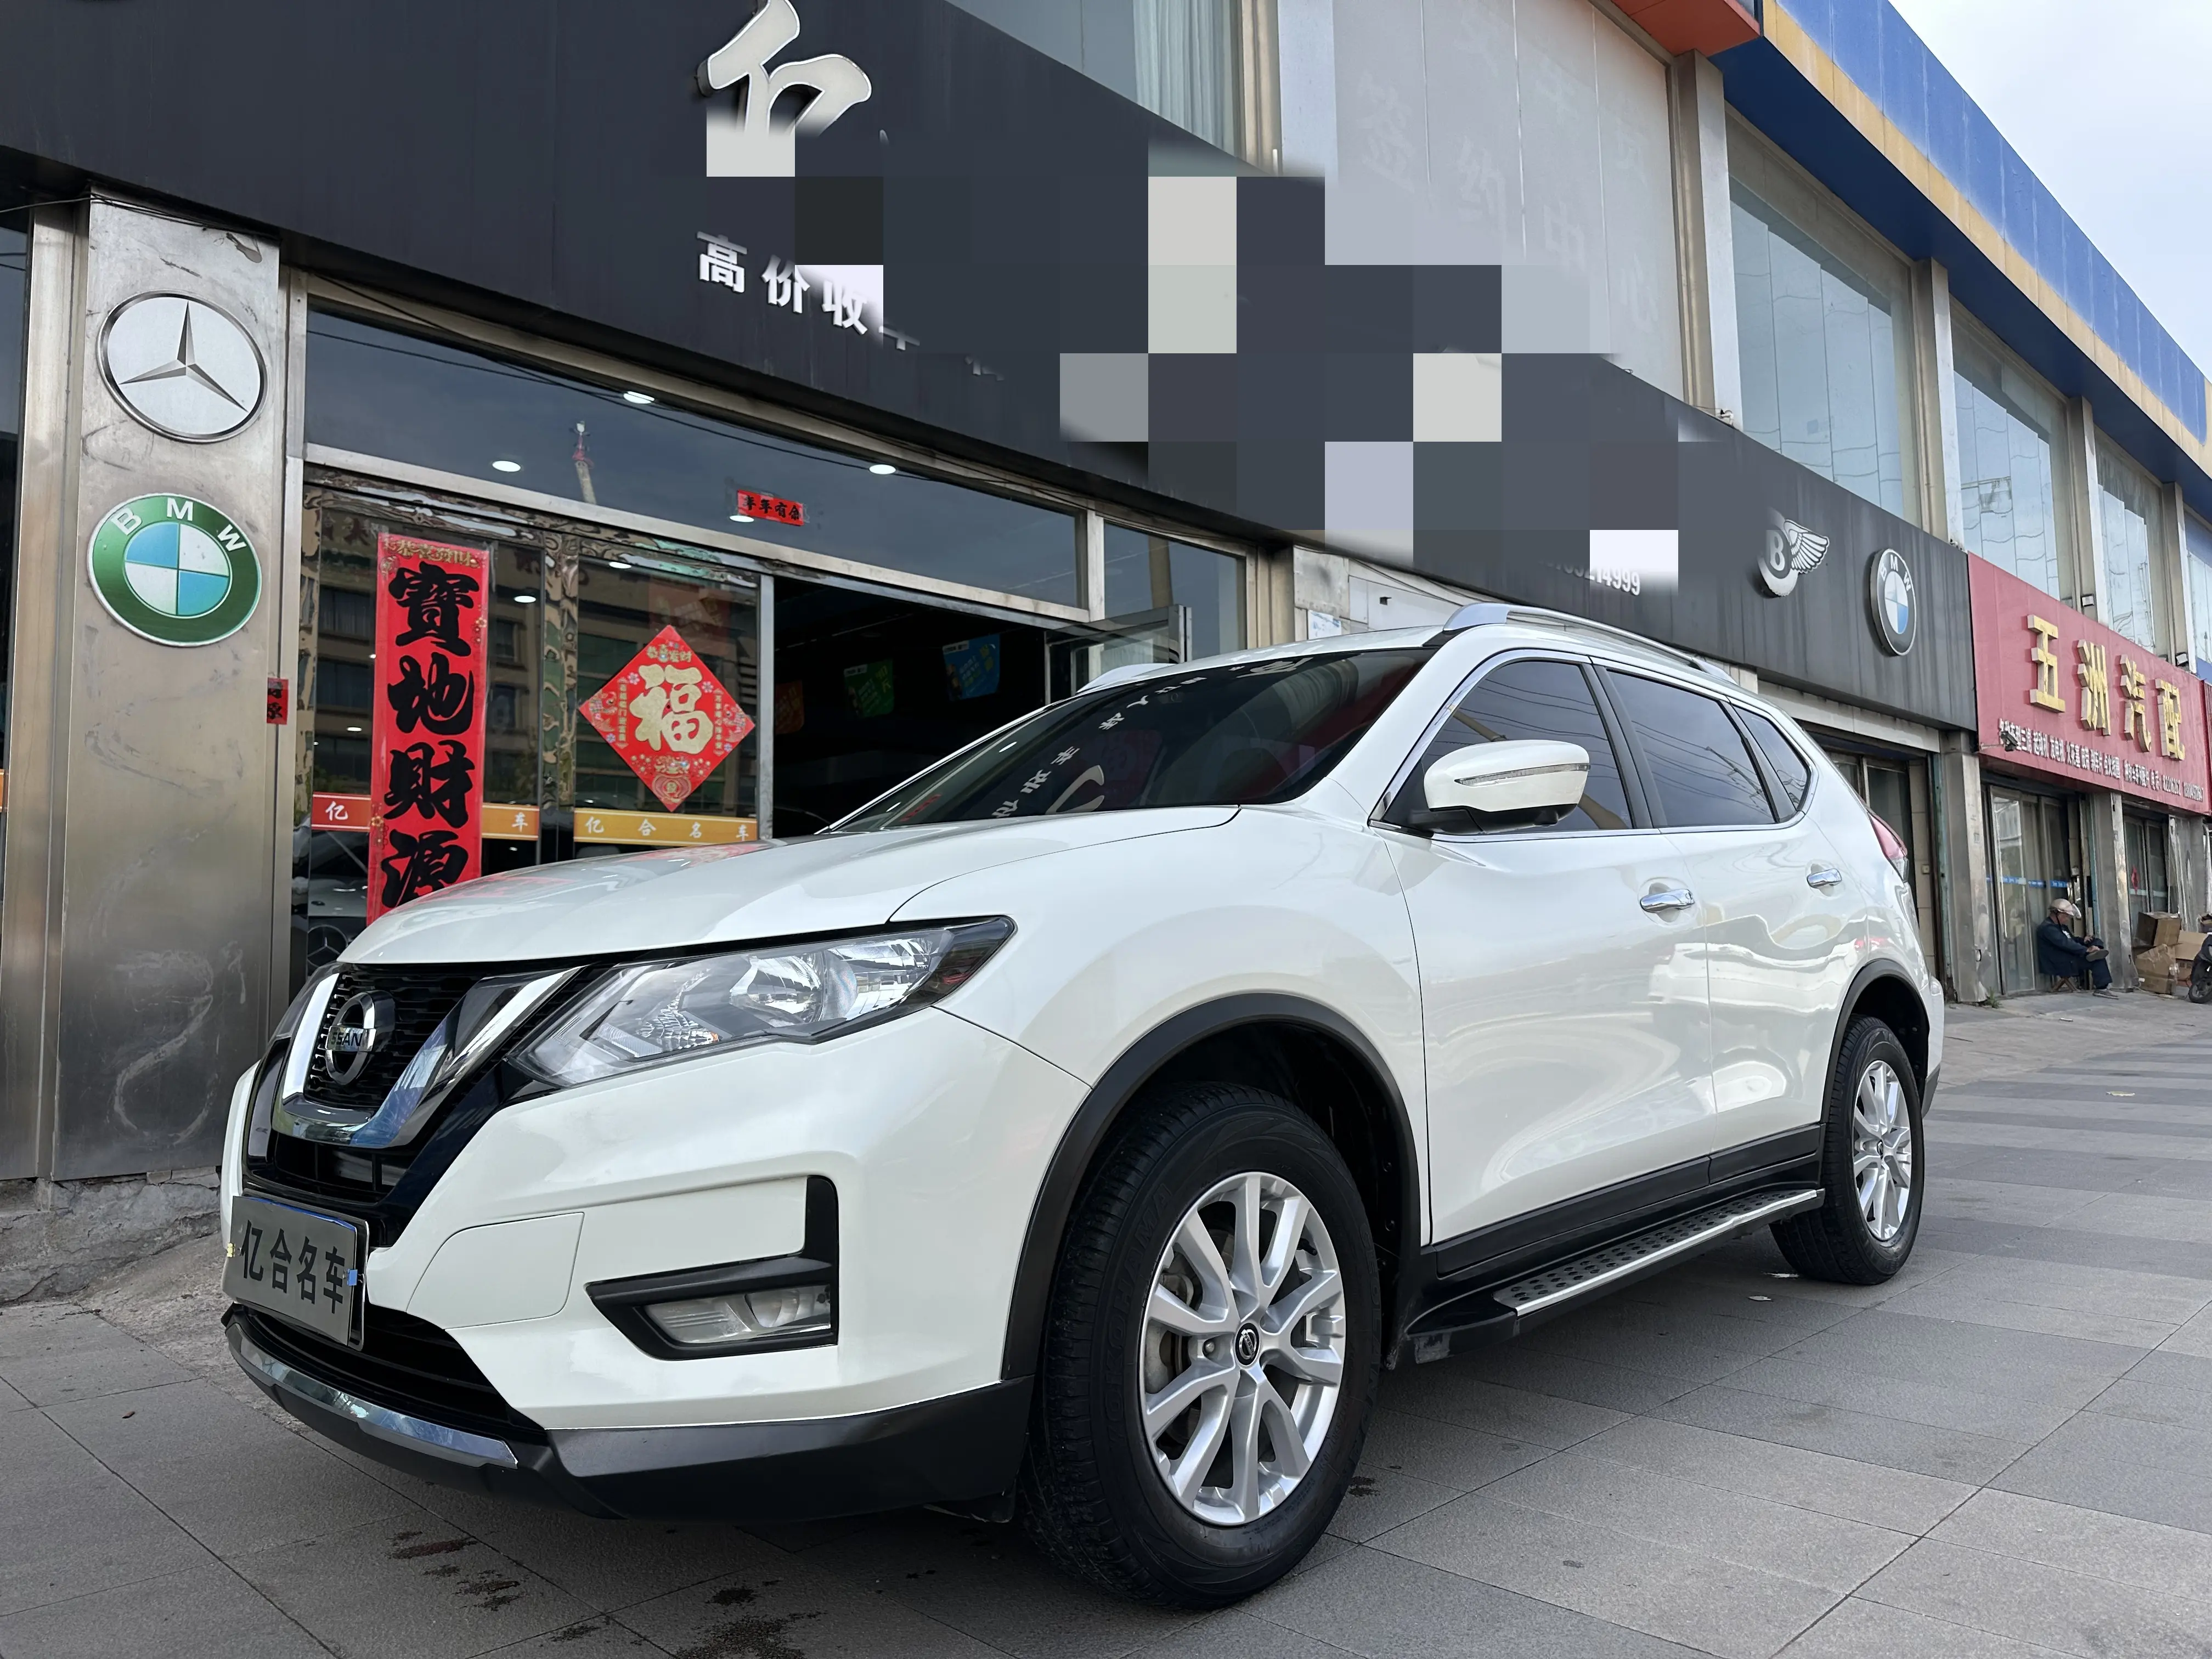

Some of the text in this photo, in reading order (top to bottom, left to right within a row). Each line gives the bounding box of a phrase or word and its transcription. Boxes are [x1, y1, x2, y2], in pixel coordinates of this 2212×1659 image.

[696, 230, 921, 351] 高价收
[111, 498, 247, 552] BMW
[1880, 554, 1912, 591] BMW
[629, 662, 714, 755] 福
[2027, 614, 2186, 761] 五洲汽配
[585, 816, 749, 842] 亿合名车
[241, 1219, 346, 1314] 亿合名车
